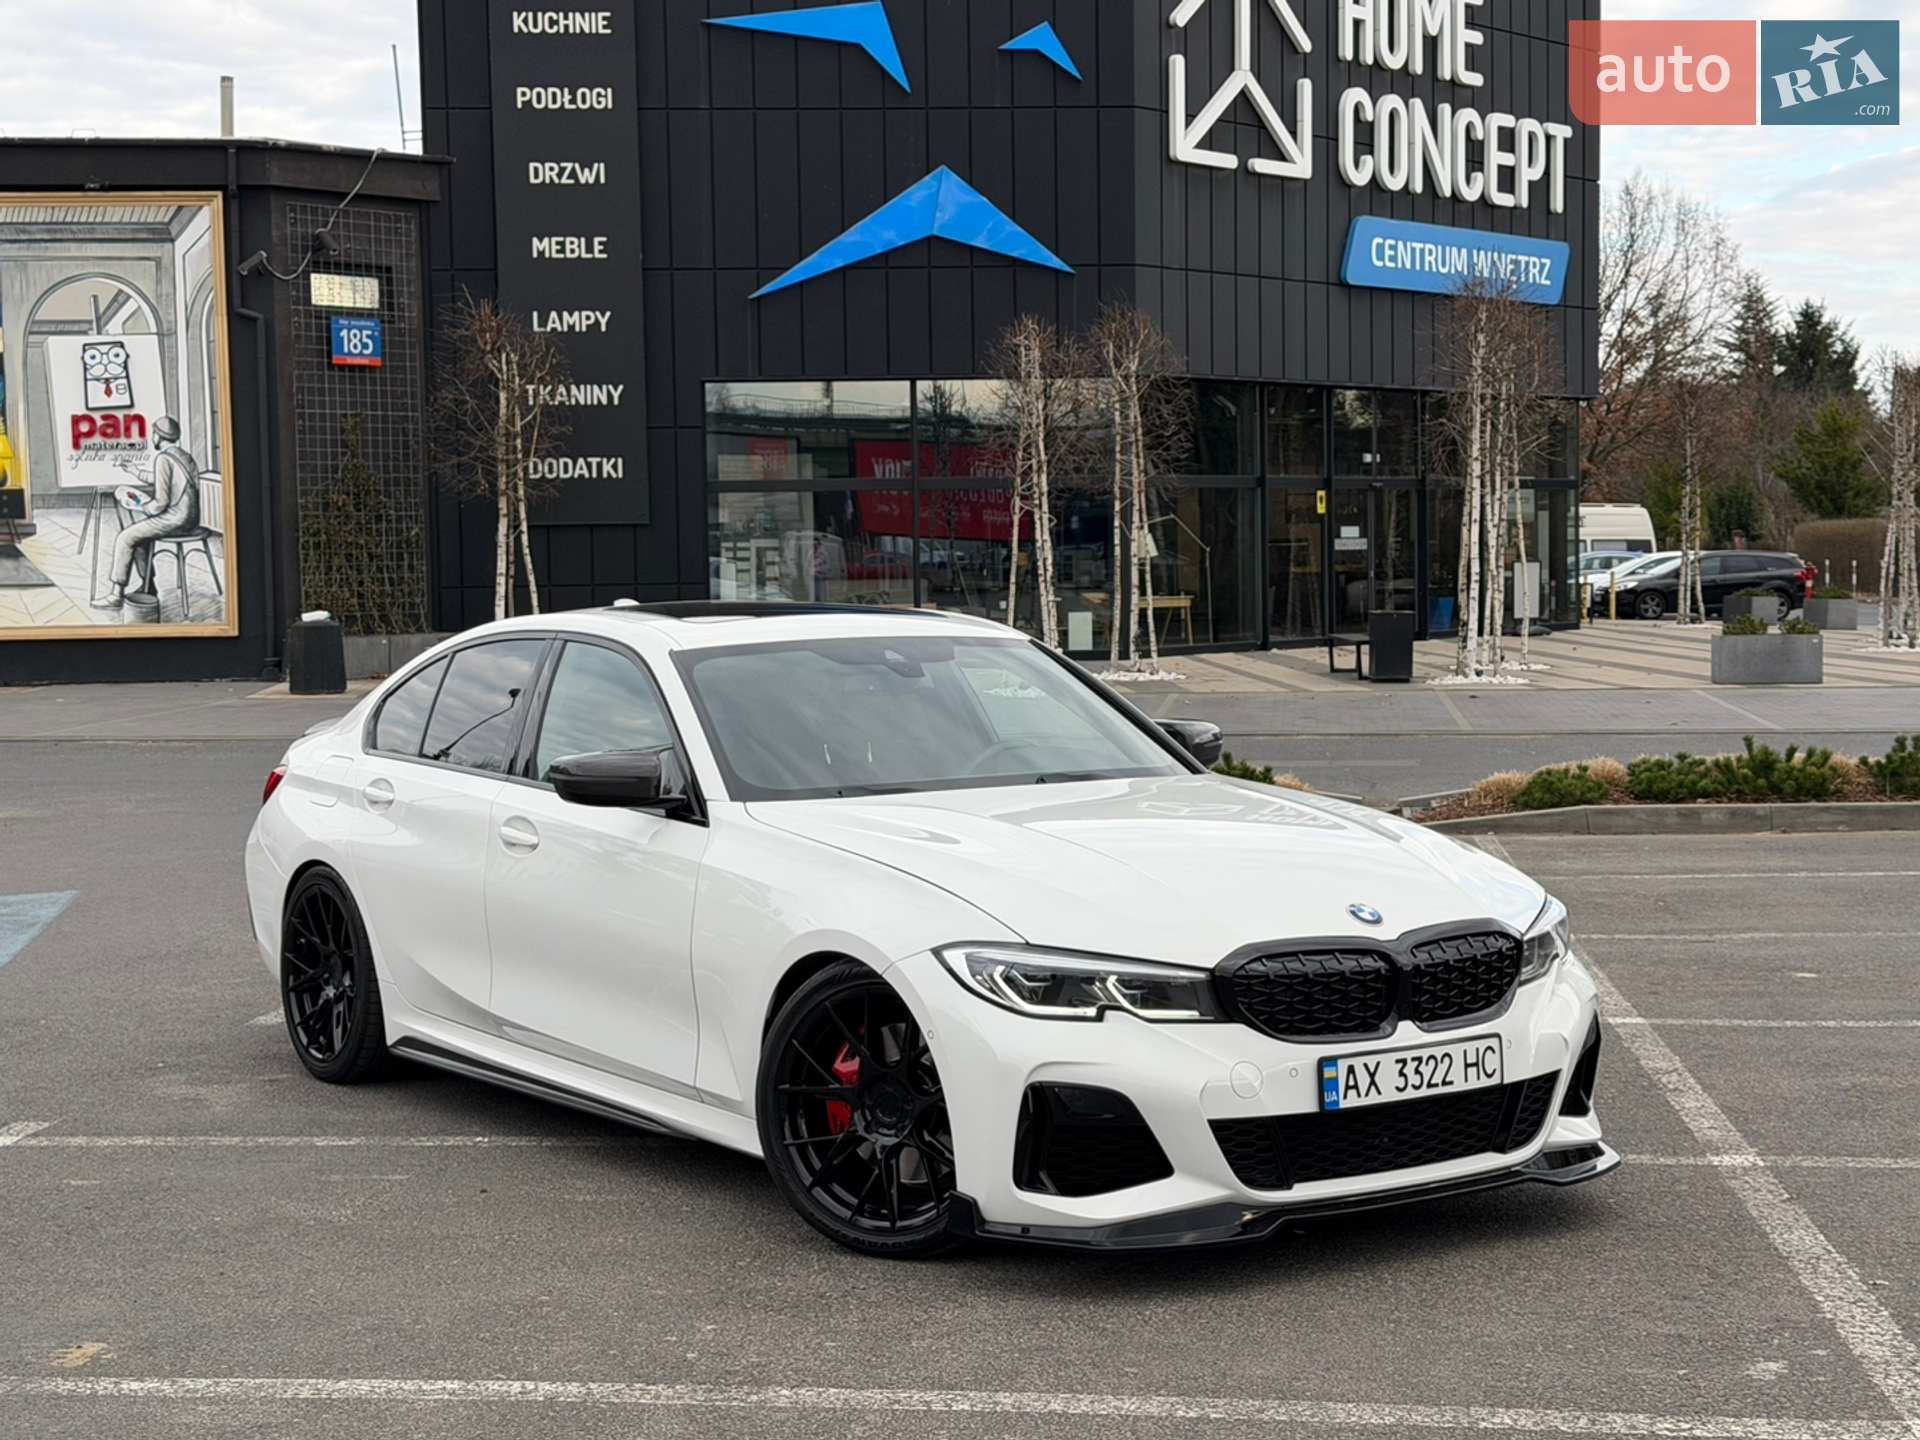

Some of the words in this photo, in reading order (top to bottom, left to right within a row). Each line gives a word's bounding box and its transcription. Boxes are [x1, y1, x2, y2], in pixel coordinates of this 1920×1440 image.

[512, 11, 612, 34] KUCHNIE
[1338, 0, 1485, 87] HOME
[516, 87, 613, 109] PODŁOGI
[1338, 87, 1573, 214] CONCEPT
[528, 162, 606, 184] DRZWI
[532, 236, 608, 259] MEBLE
[1371, 237, 1468, 276] CENTRUM
[1473, 248, 1552, 288] WNĘTRZ
[532, 311, 611, 332] LAMPY
[340, 328, 374, 355] 185
[525, 384, 624, 406] TKANINY
[71, 413, 147, 451] pan
[528, 457, 624, 479] DODATKI
[1324, 1090, 1339, 1103] UA
[1343, 1061, 1382, 1100] AX
[1394, 1052, 1454, 1093] 3322
[1463, 1045, 1497, 1083] HC
